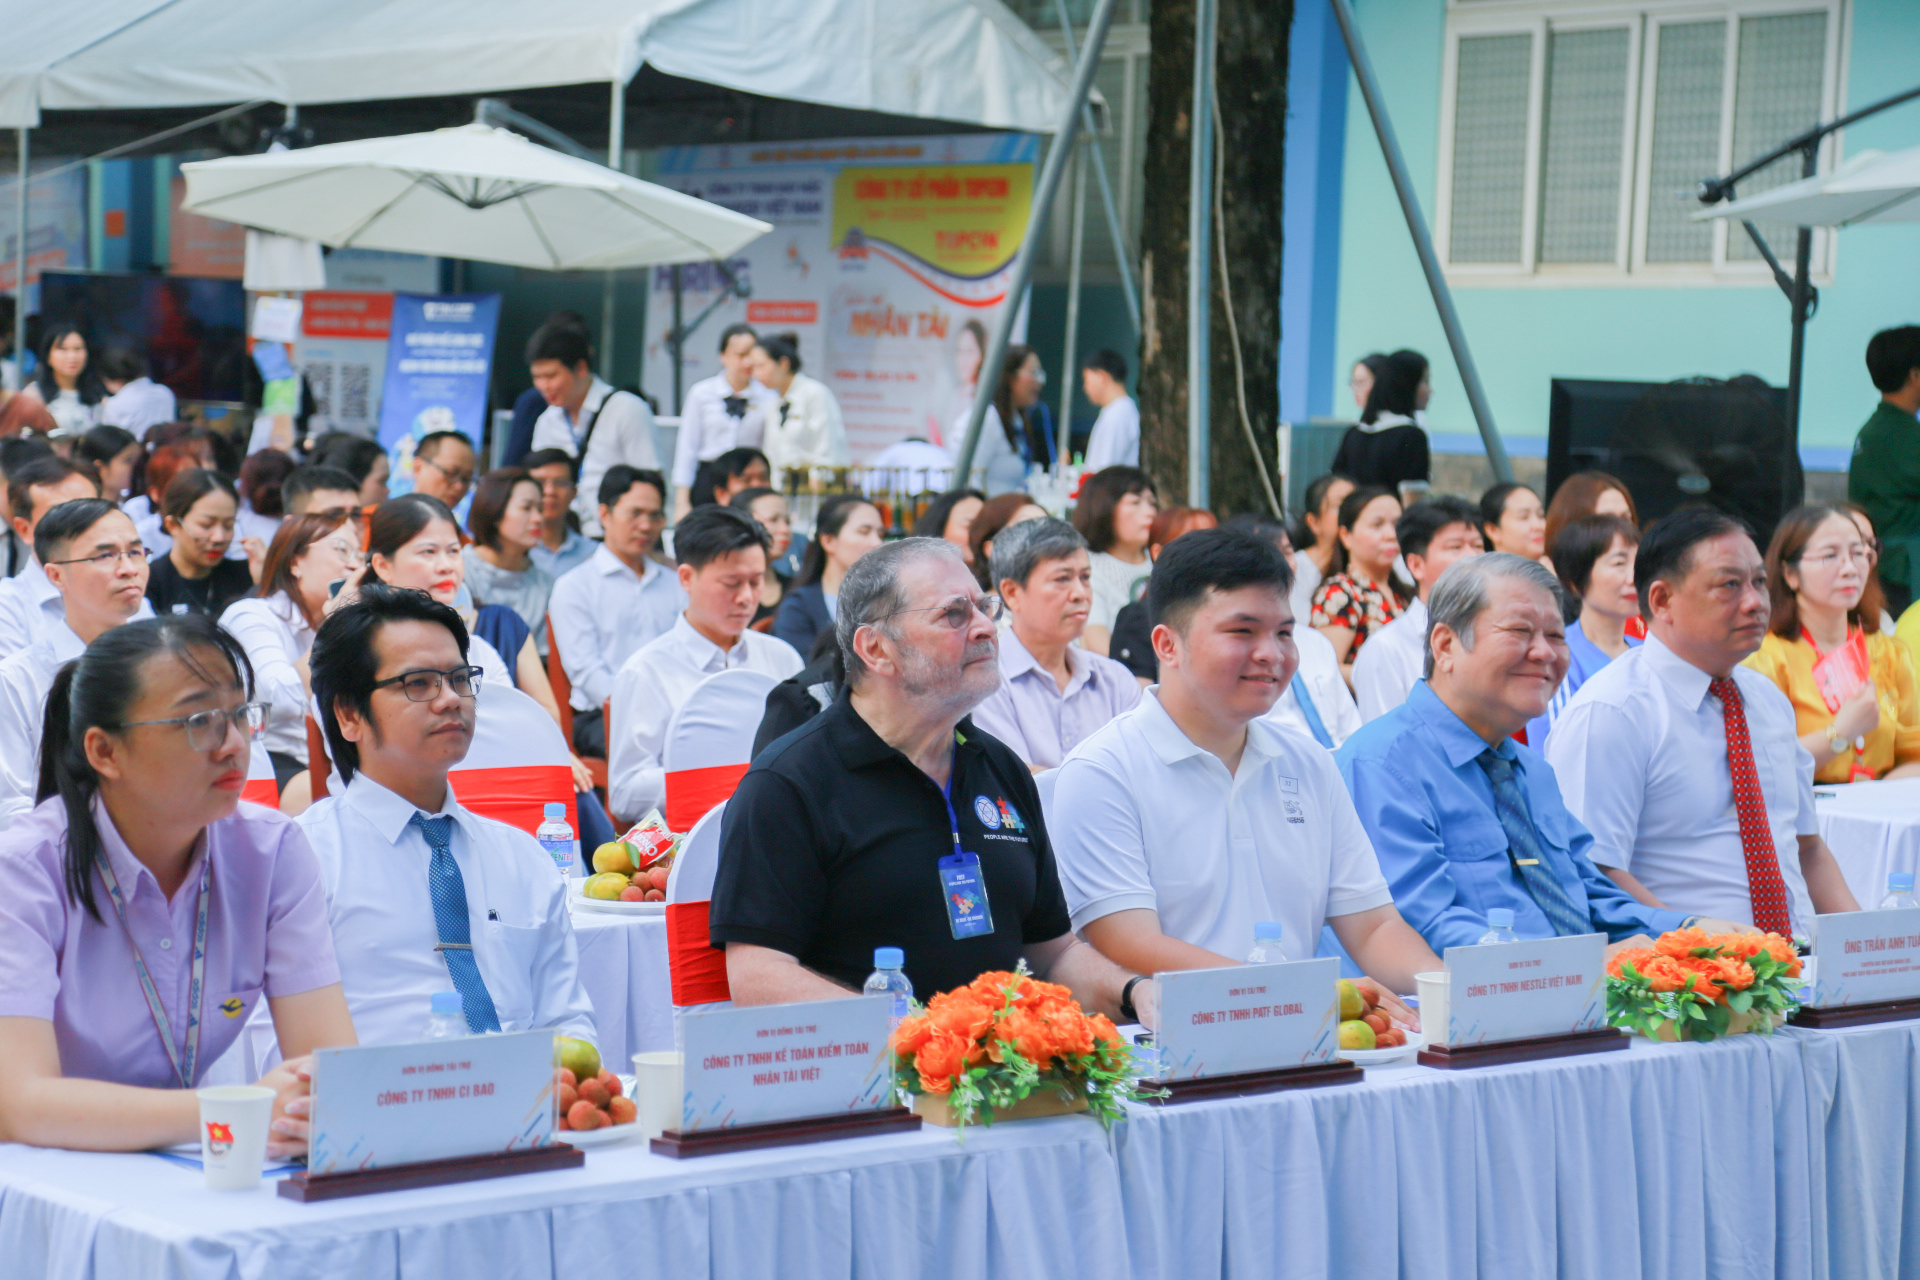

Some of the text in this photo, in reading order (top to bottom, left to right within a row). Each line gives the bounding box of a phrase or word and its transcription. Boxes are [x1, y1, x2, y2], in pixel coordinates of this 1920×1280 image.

[197, 911, 206, 943] adidas
[1888, 936, 1905, 950] ANH
[191, 978, 200, 1010] adidas
[1467, 974, 1583, 997] CÔNG TY TNHH NESTLÉ VIỆT NAM
[1192, 1011, 1215, 1025] CÔNG
[1217, 1011, 1226, 1022] TY
[1229, 1008, 1250, 1021] TNHH
[1274, 1003, 1304, 1017] GLOBAL
[186, 1045, 194, 1077] adidas
[703, 1040, 869, 1070] CÔNG TY TNHH KẾ TOÁN KIỂM TOÁN
[753, 1067, 821, 1086] NHÂN TÀI VIỆT
[377, 1082, 495, 1107] CÔNG TY TNHH CI BAO
